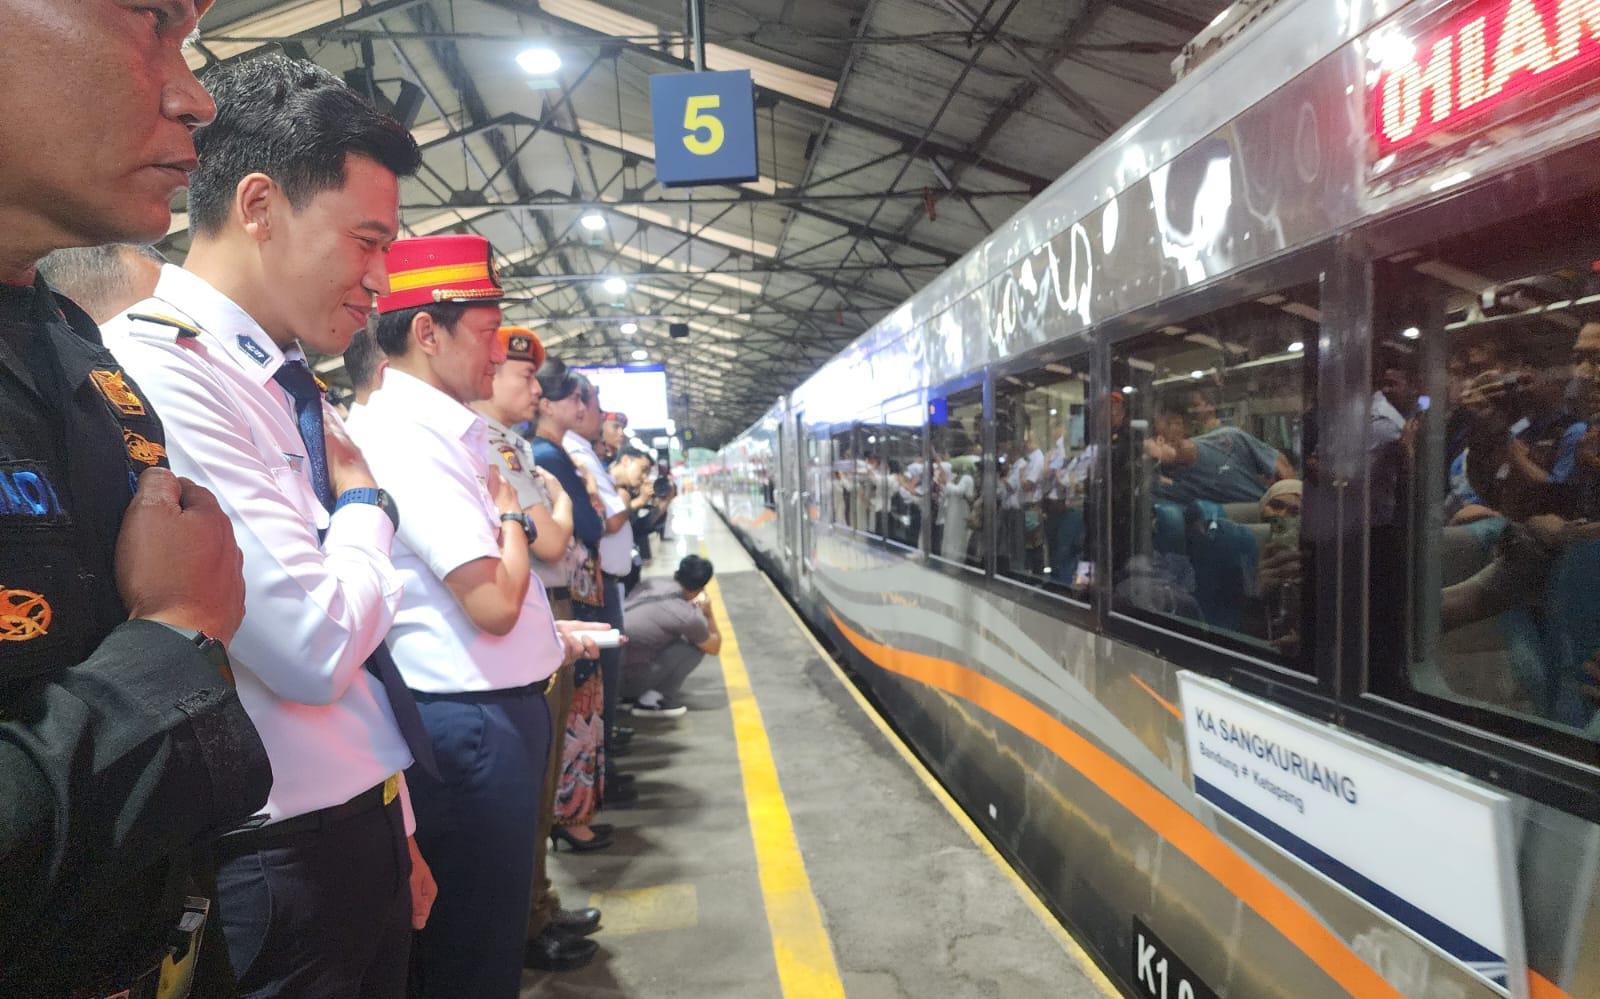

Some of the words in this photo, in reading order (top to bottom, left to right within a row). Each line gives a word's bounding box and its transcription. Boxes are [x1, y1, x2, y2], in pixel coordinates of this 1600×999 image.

[682, 95, 725, 156] 5
[1195, 706, 1217, 736] KA
[1219, 718, 1359, 805] SANGKURIANG
[1199, 741, 1240, 778] Bandung
[1252, 769, 1305, 815] Ketapang
